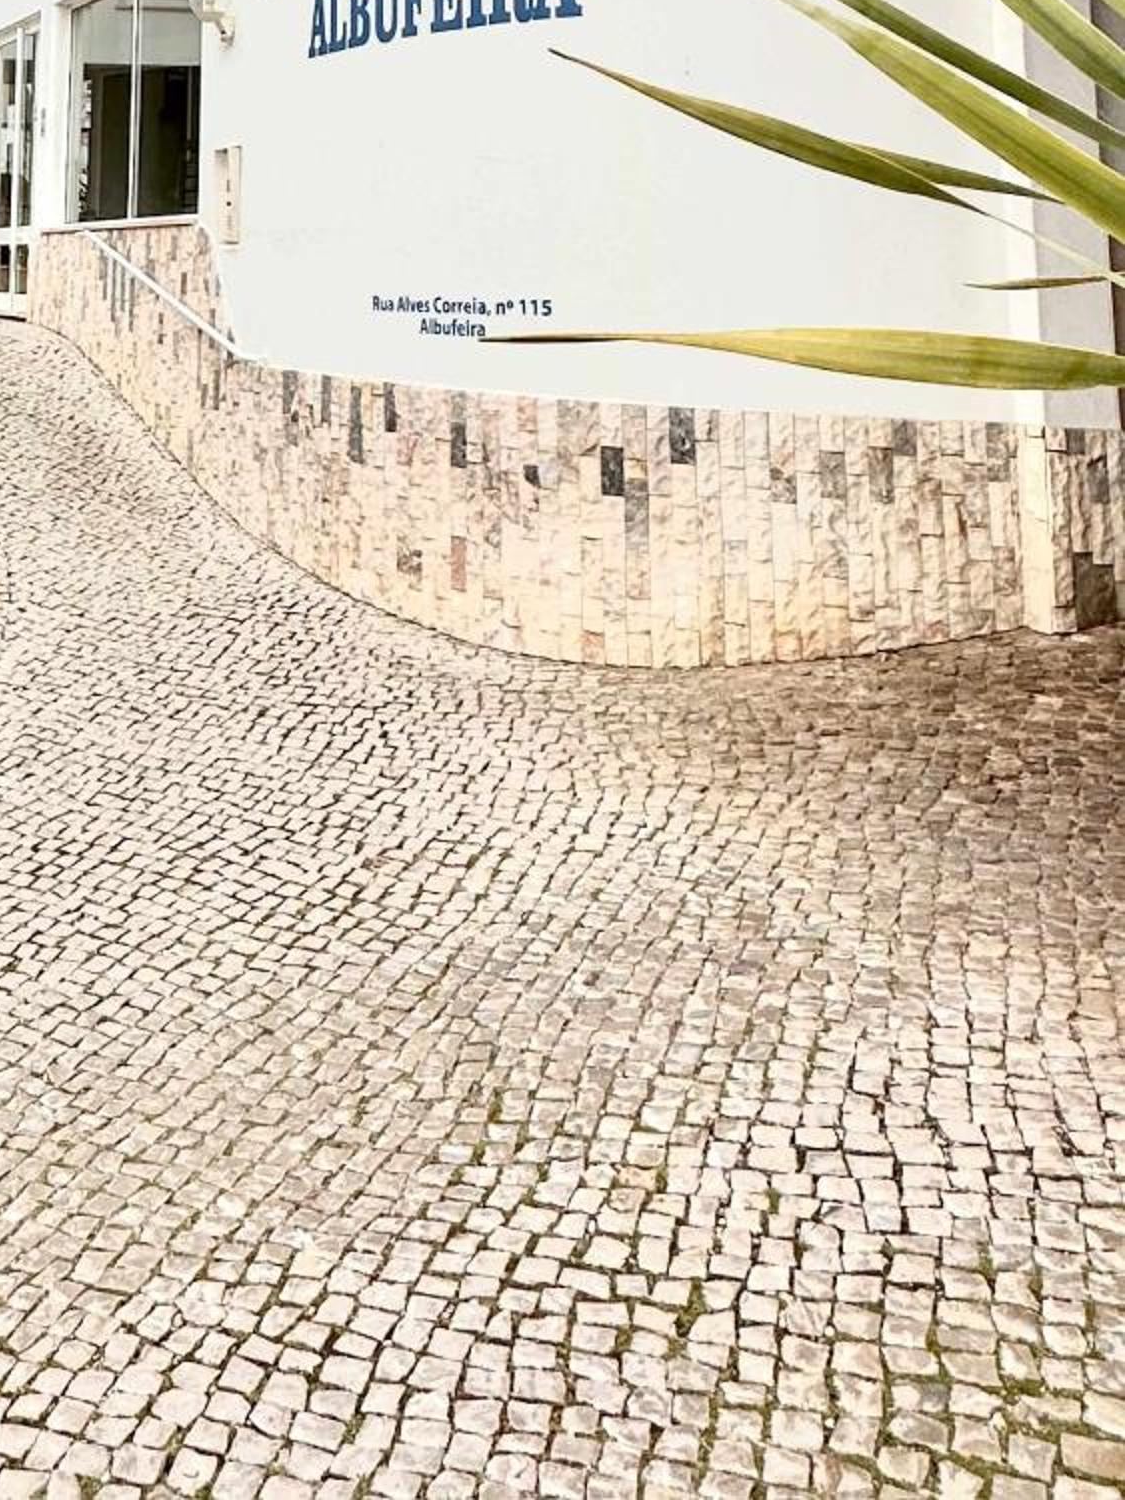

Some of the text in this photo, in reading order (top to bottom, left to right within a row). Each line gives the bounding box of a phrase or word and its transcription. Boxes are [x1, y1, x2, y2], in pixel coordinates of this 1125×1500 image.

[372, 296, 552, 316] Rua Alves Correia, nº 115
[420, 318, 486, 336] Albufeira
